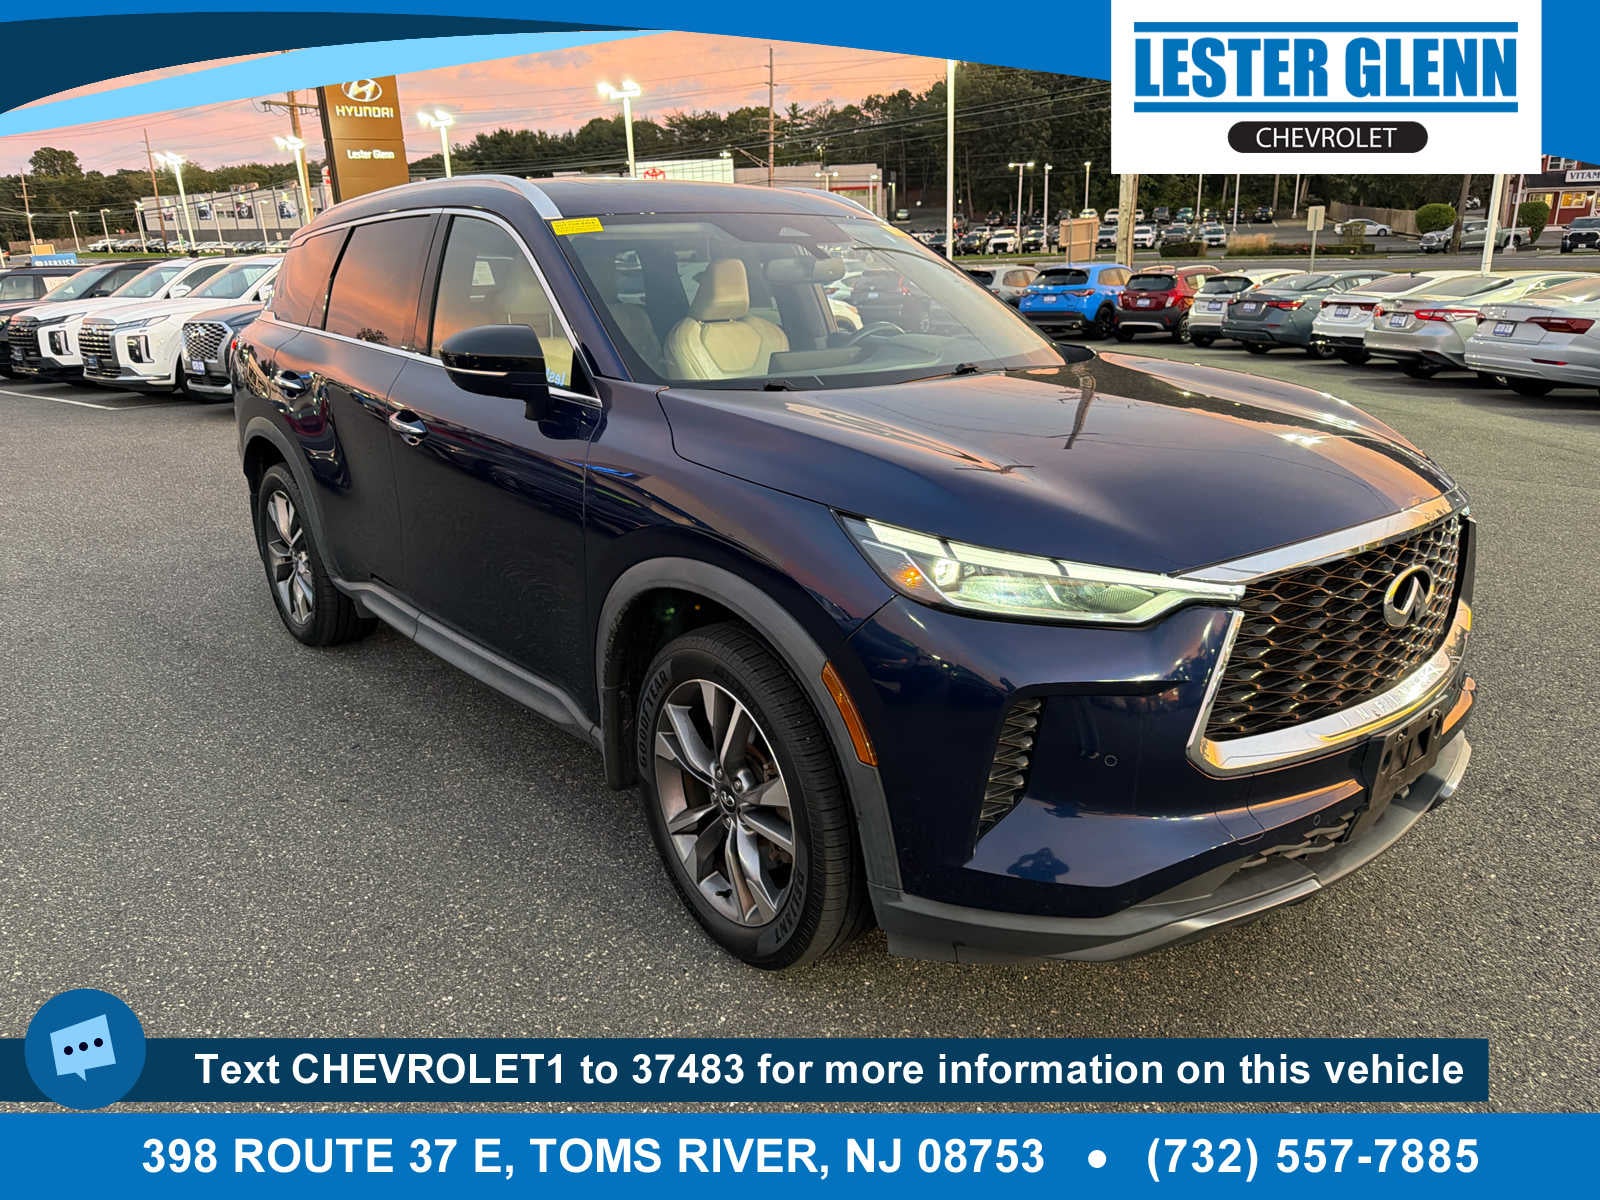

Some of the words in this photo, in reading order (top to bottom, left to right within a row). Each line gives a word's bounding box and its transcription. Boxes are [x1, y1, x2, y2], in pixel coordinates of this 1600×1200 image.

[335, 105, 394, 118] HYUNDAI
[346, 149, 371, 159] Lester
[372, 149, 395, 159] Glenn
[639, 669, 668, 769] GOODYEAR
